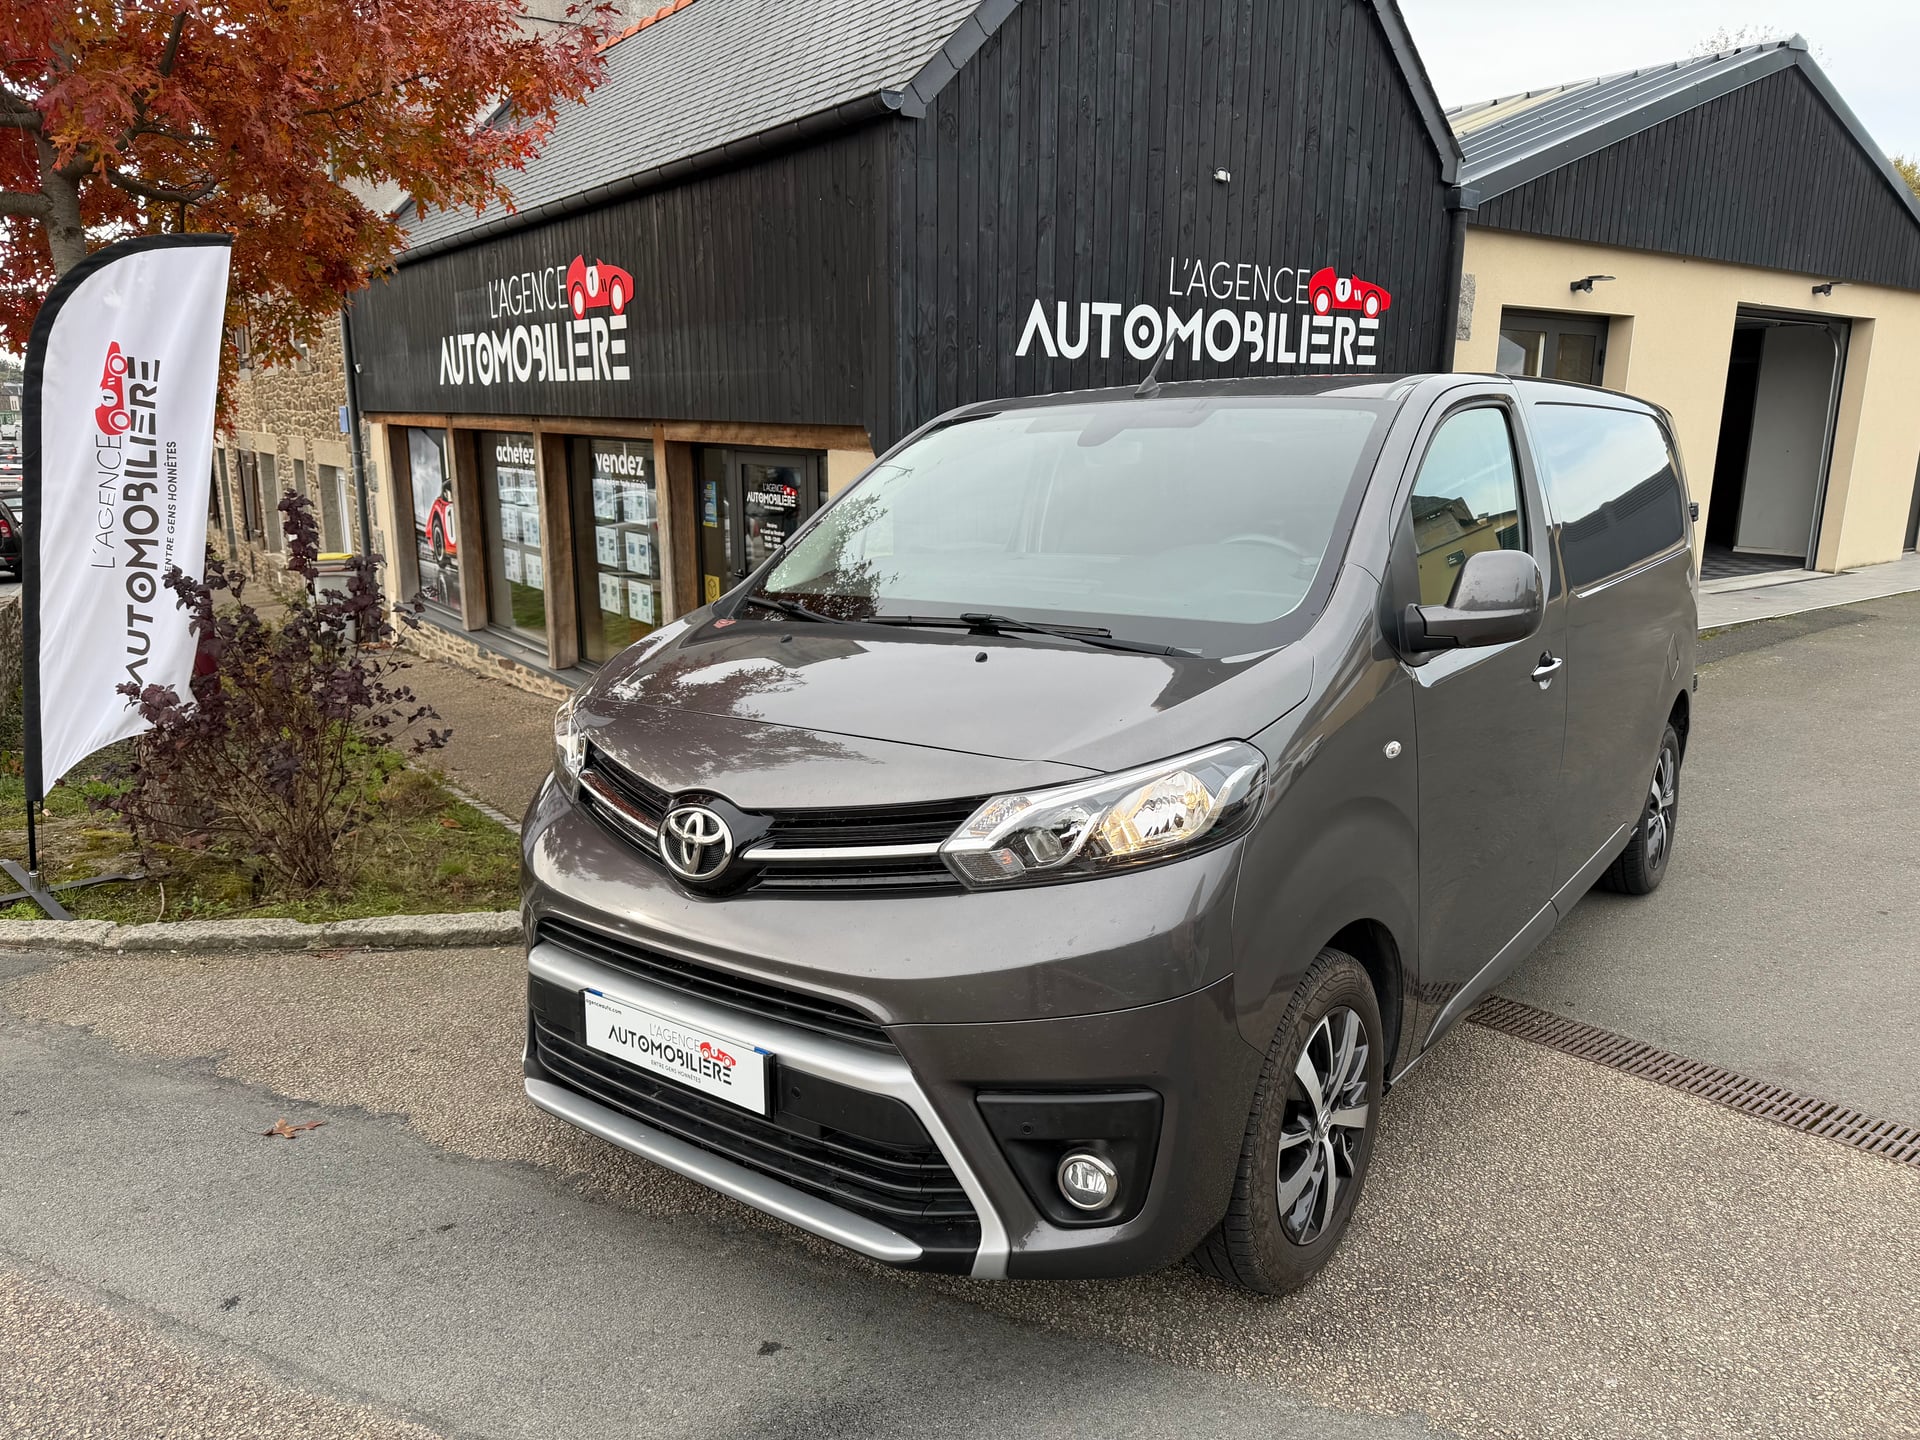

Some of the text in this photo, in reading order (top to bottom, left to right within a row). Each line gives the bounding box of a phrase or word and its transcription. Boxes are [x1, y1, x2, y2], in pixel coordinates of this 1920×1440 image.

[488, 265, 569, 319] L'AGENCE
[1169, 256, 1310, 305] L'AGENCE
[439, 314, 631, 386] AUTOMOBILIERE
[1015, 298, 1379, 366] AUTOMOBILIERE
[495, 436, 536, 465] achetez
[594, 442, 645, 476] vendez
[91, 434, 122, 569] L'AGENCE
[164, 441, 178, 572] ENTRE GENS HONNÊTES
[649, 1023, 700, 1053] L'AGENCE
